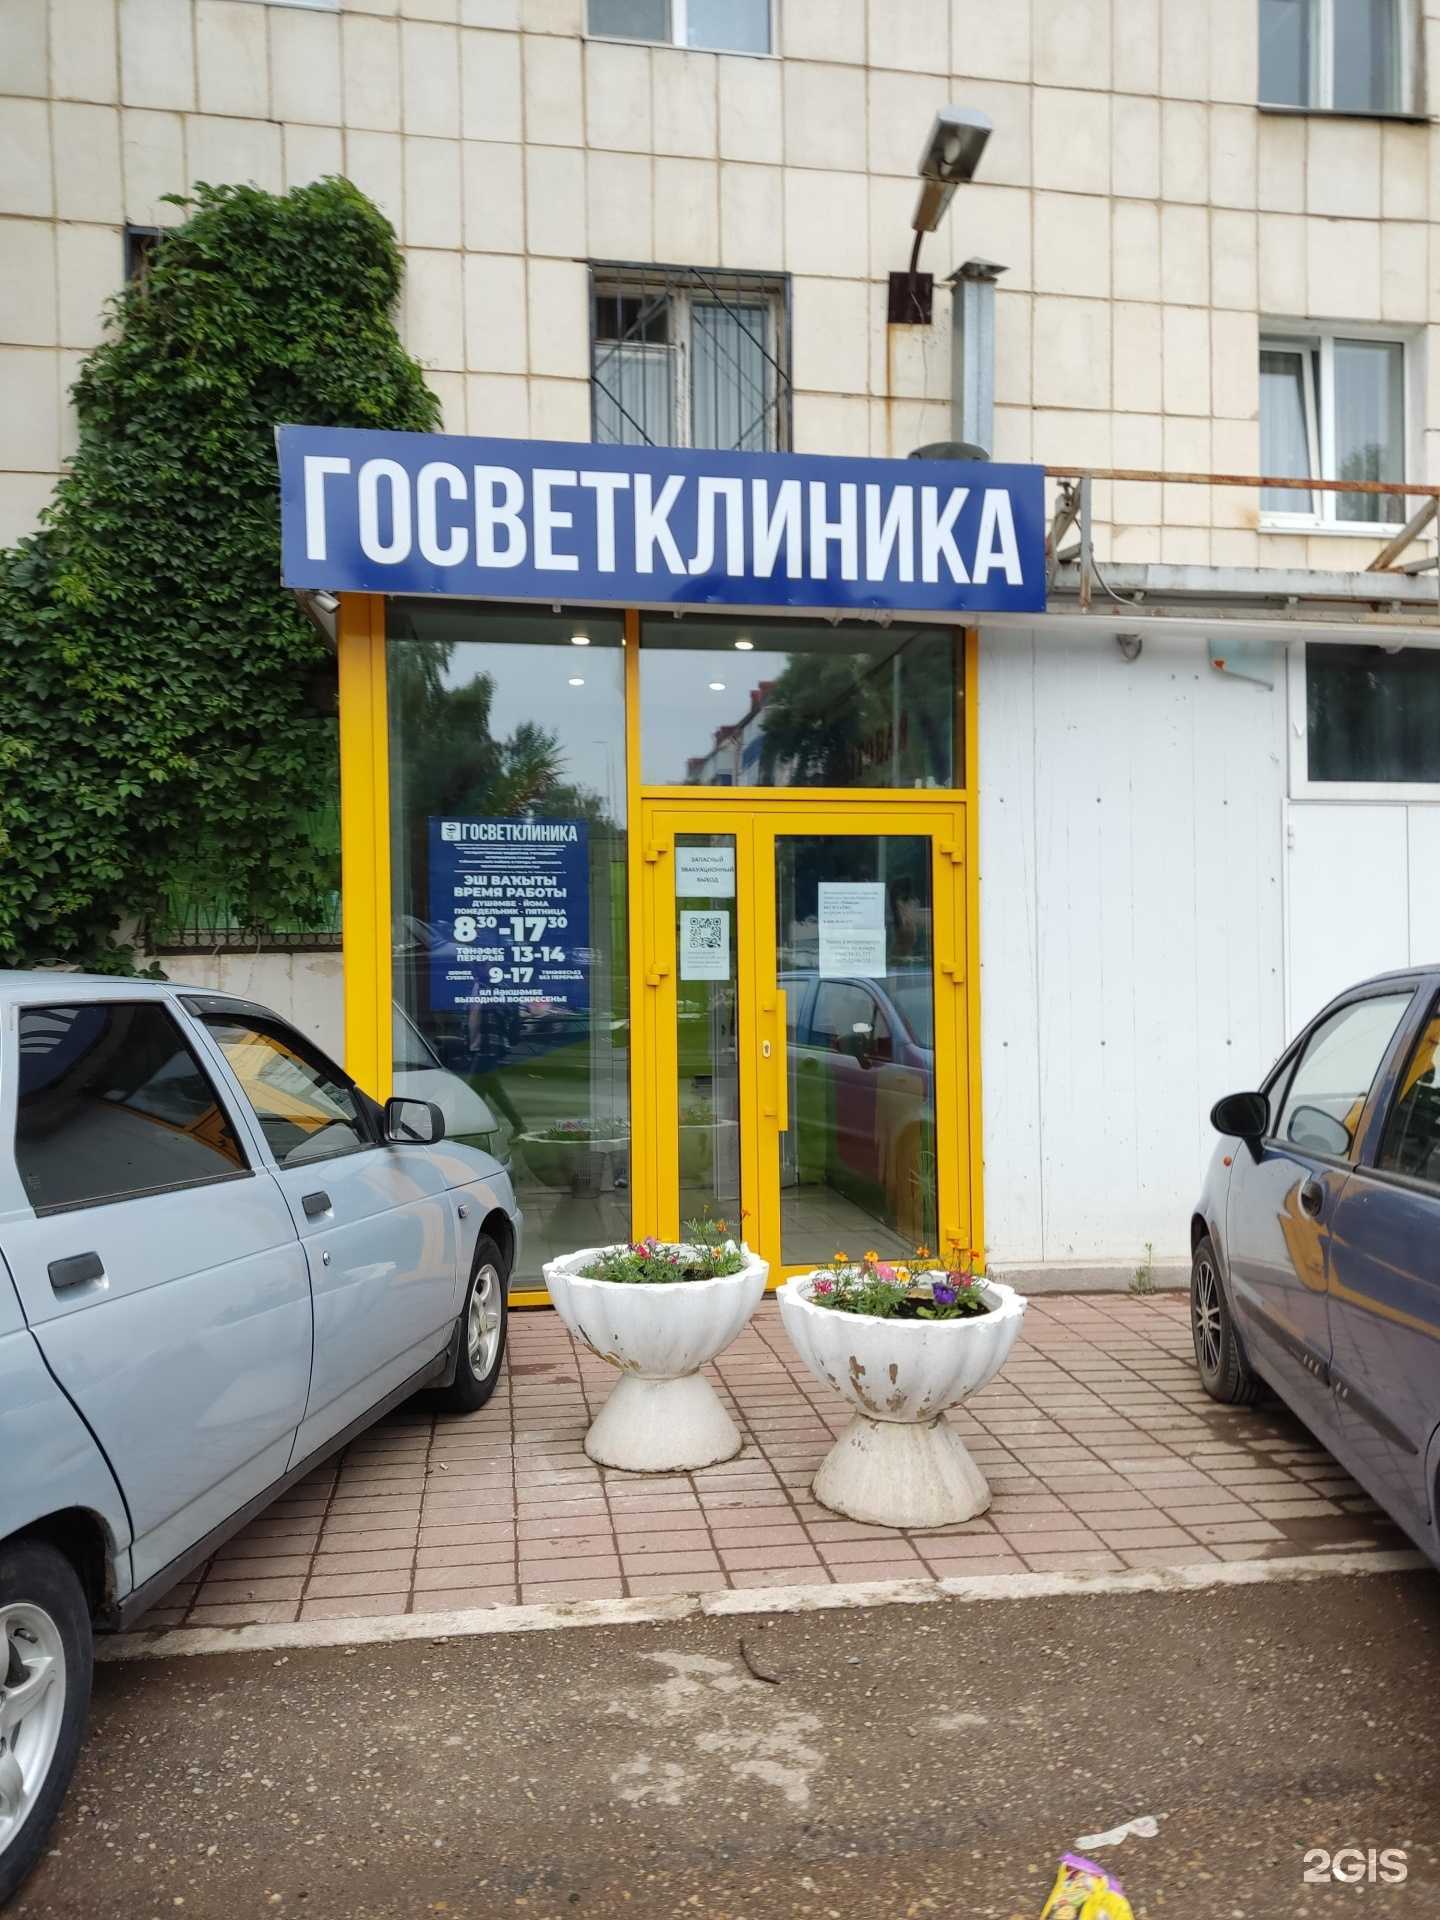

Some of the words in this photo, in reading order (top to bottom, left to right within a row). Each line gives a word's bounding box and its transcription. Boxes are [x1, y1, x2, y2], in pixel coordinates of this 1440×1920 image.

[303, 454, 1024, 587] ГОСВЕТКЛИНИКА
[462, 823, 578, 842] ГОСВЕТКЛИНИКА
[463, 875, 488, 886] ЭШ
[453, 887, 502, 898] ВРЕМЯ
[506, 887, 567, 898] РАБОТЫ
[454, 907, 518, 915] ПОНЕДЕЛЬНИК
[525, 908, 567, 916] ПЯТНИЦА
[456, 954, 505, 962] ПЕРЕРЫВ
[511, 947, 566, 962] 13-14
[488, 967, 534, 983] 9-17
[454, 995, 505, 1004] ВЫХОДНОЙ
[506, 995, 568, 1003] ВОСКРЕСЕНЬЕ
